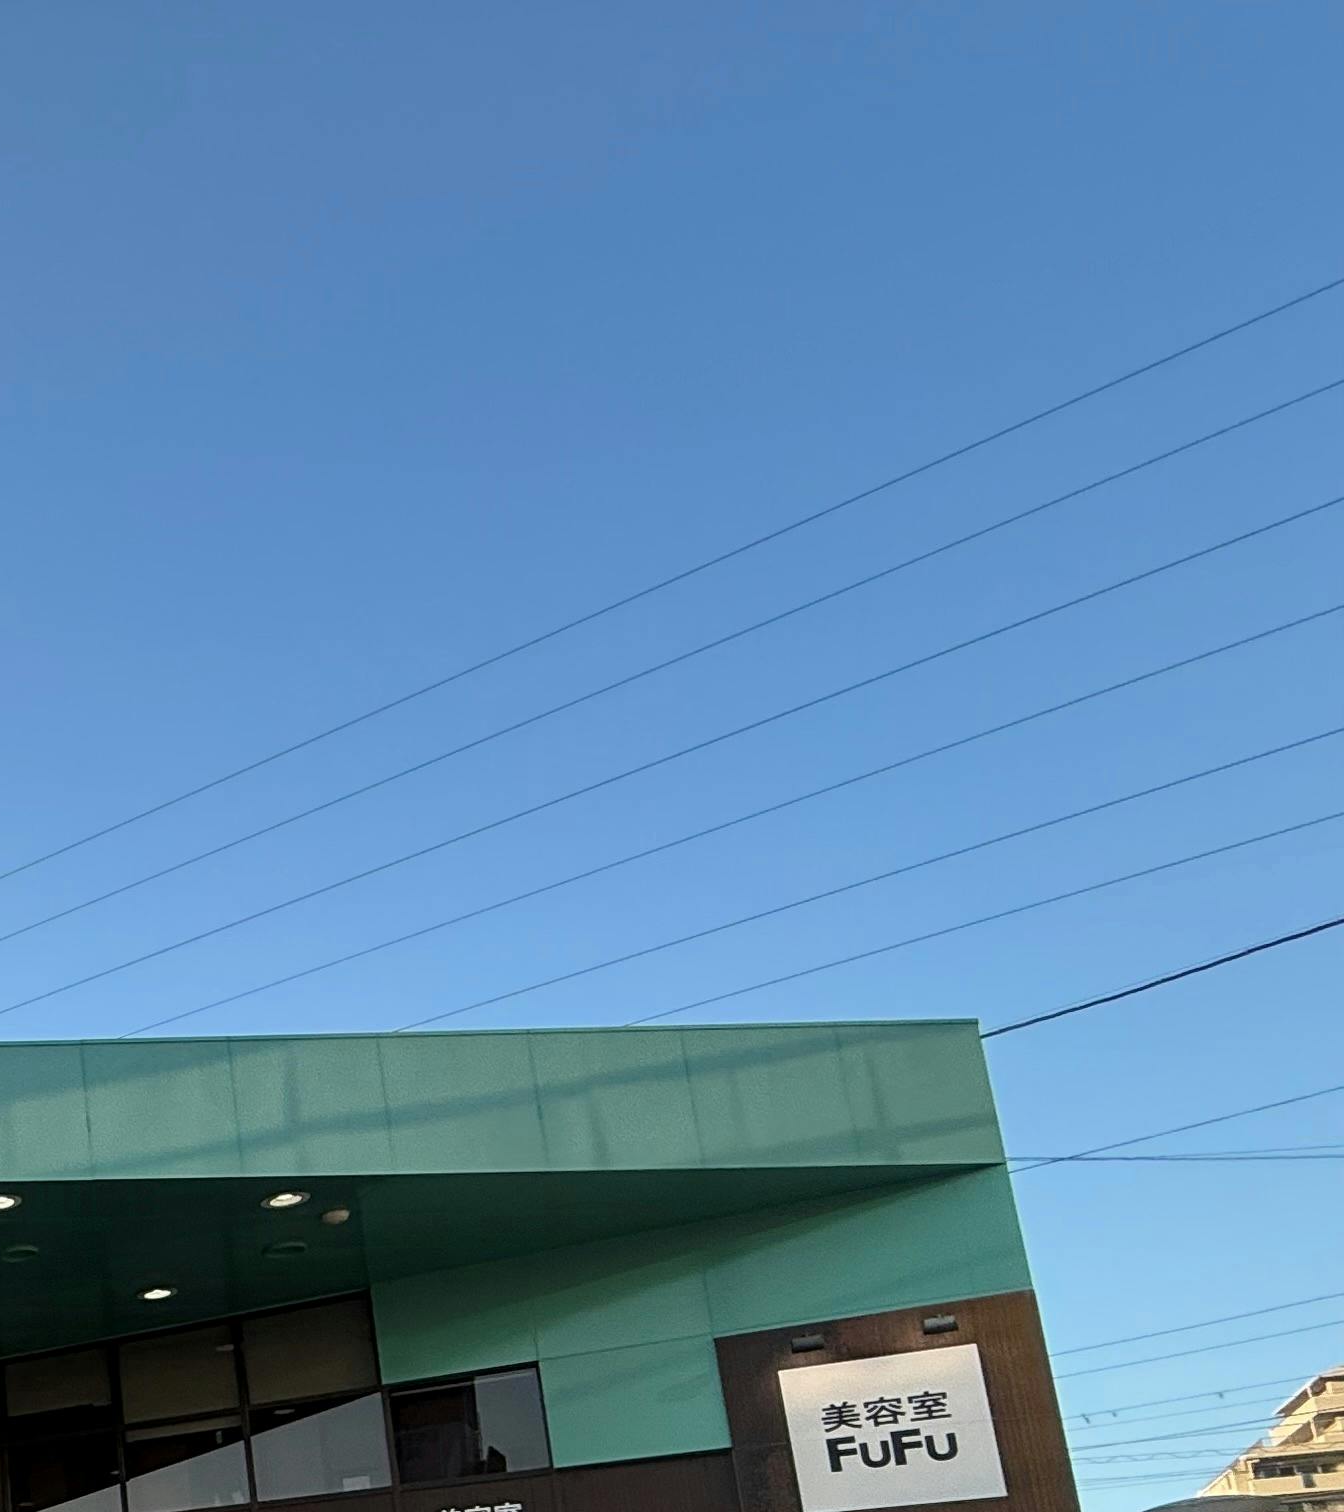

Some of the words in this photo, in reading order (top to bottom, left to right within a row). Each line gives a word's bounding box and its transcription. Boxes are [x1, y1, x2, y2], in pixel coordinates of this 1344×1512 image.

[821, 1391, 953, 1432] 美容室
[825, 1428, 959, 1473] FuFu
